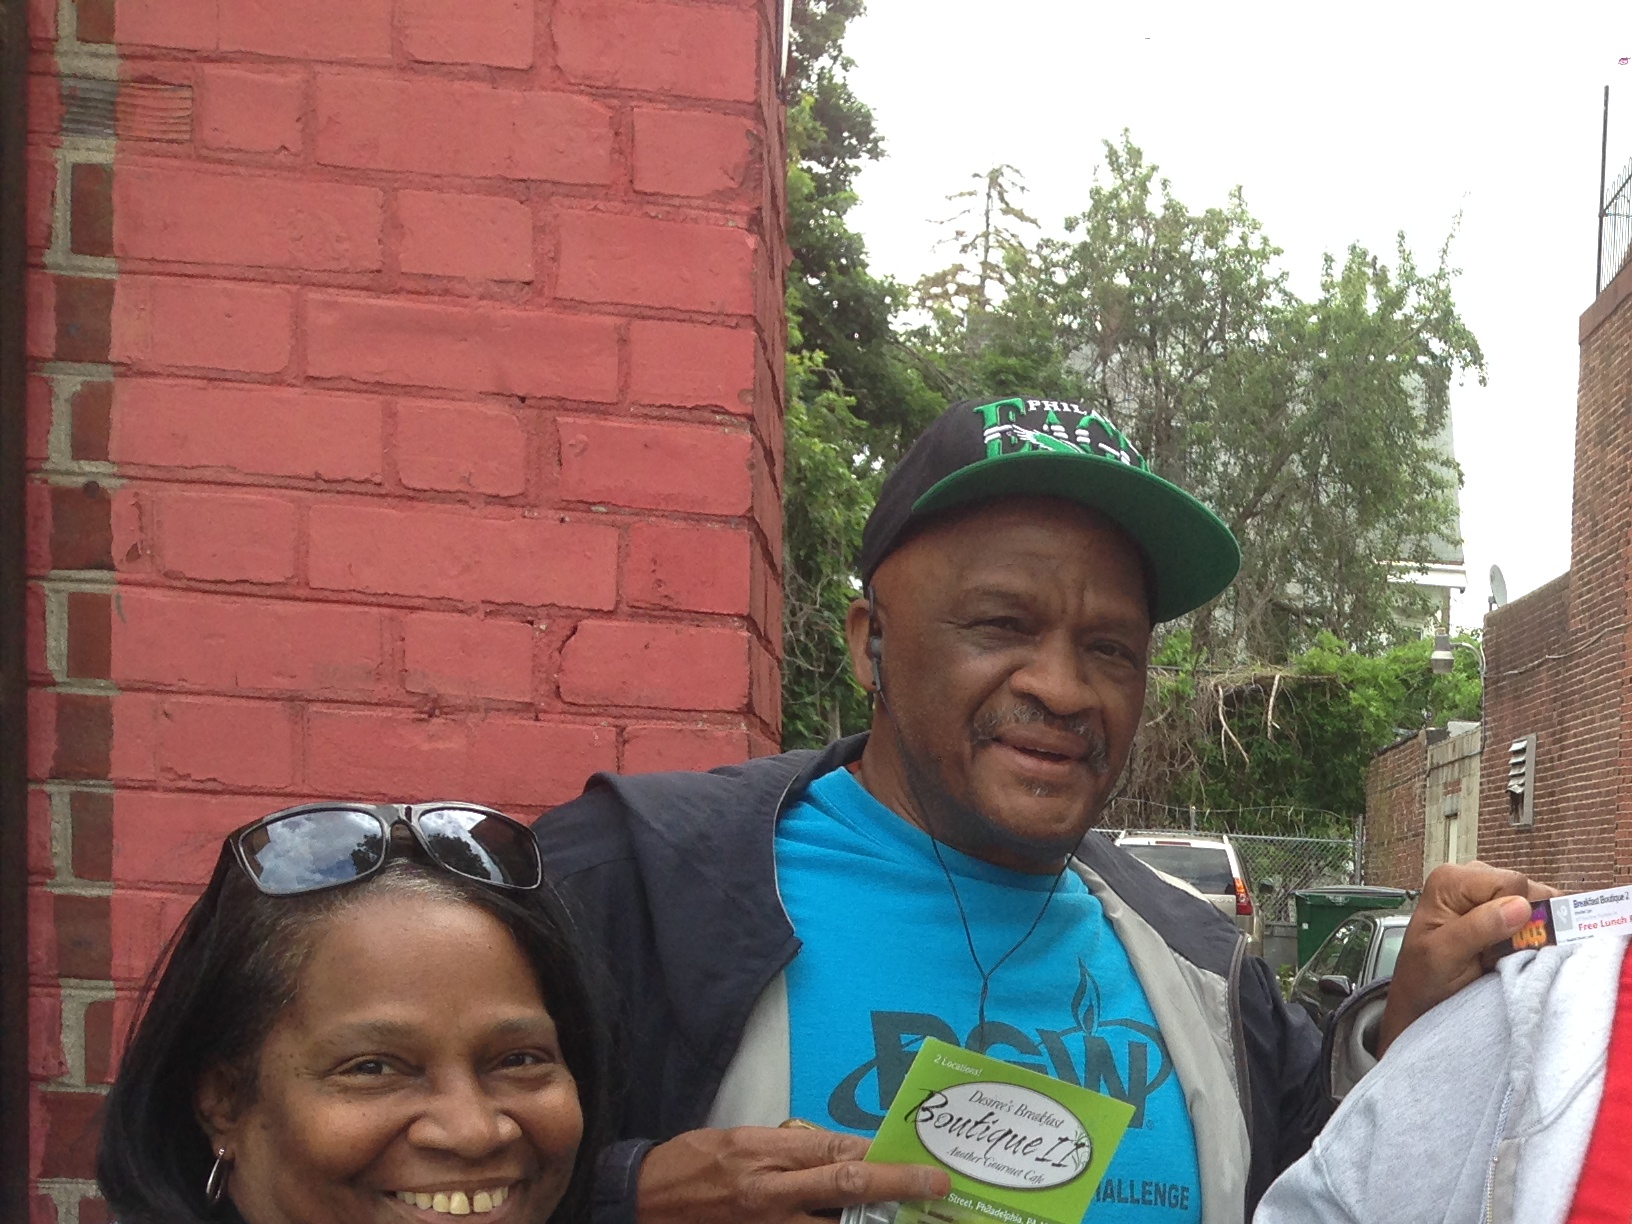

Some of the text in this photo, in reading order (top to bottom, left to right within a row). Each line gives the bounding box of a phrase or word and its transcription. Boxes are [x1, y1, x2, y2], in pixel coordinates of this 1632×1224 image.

[1578, 922, 1598, 931] Free
[1600, 916, 1627, 928] Lunch
[933, 1054, 984, 1077] 2 Locations!
[904, 1088, 1044, 1160] Boutique
[1014, 1103, 1065, 1129] Breakfast
[983, 1156, 1024, 1178] Gourmet
